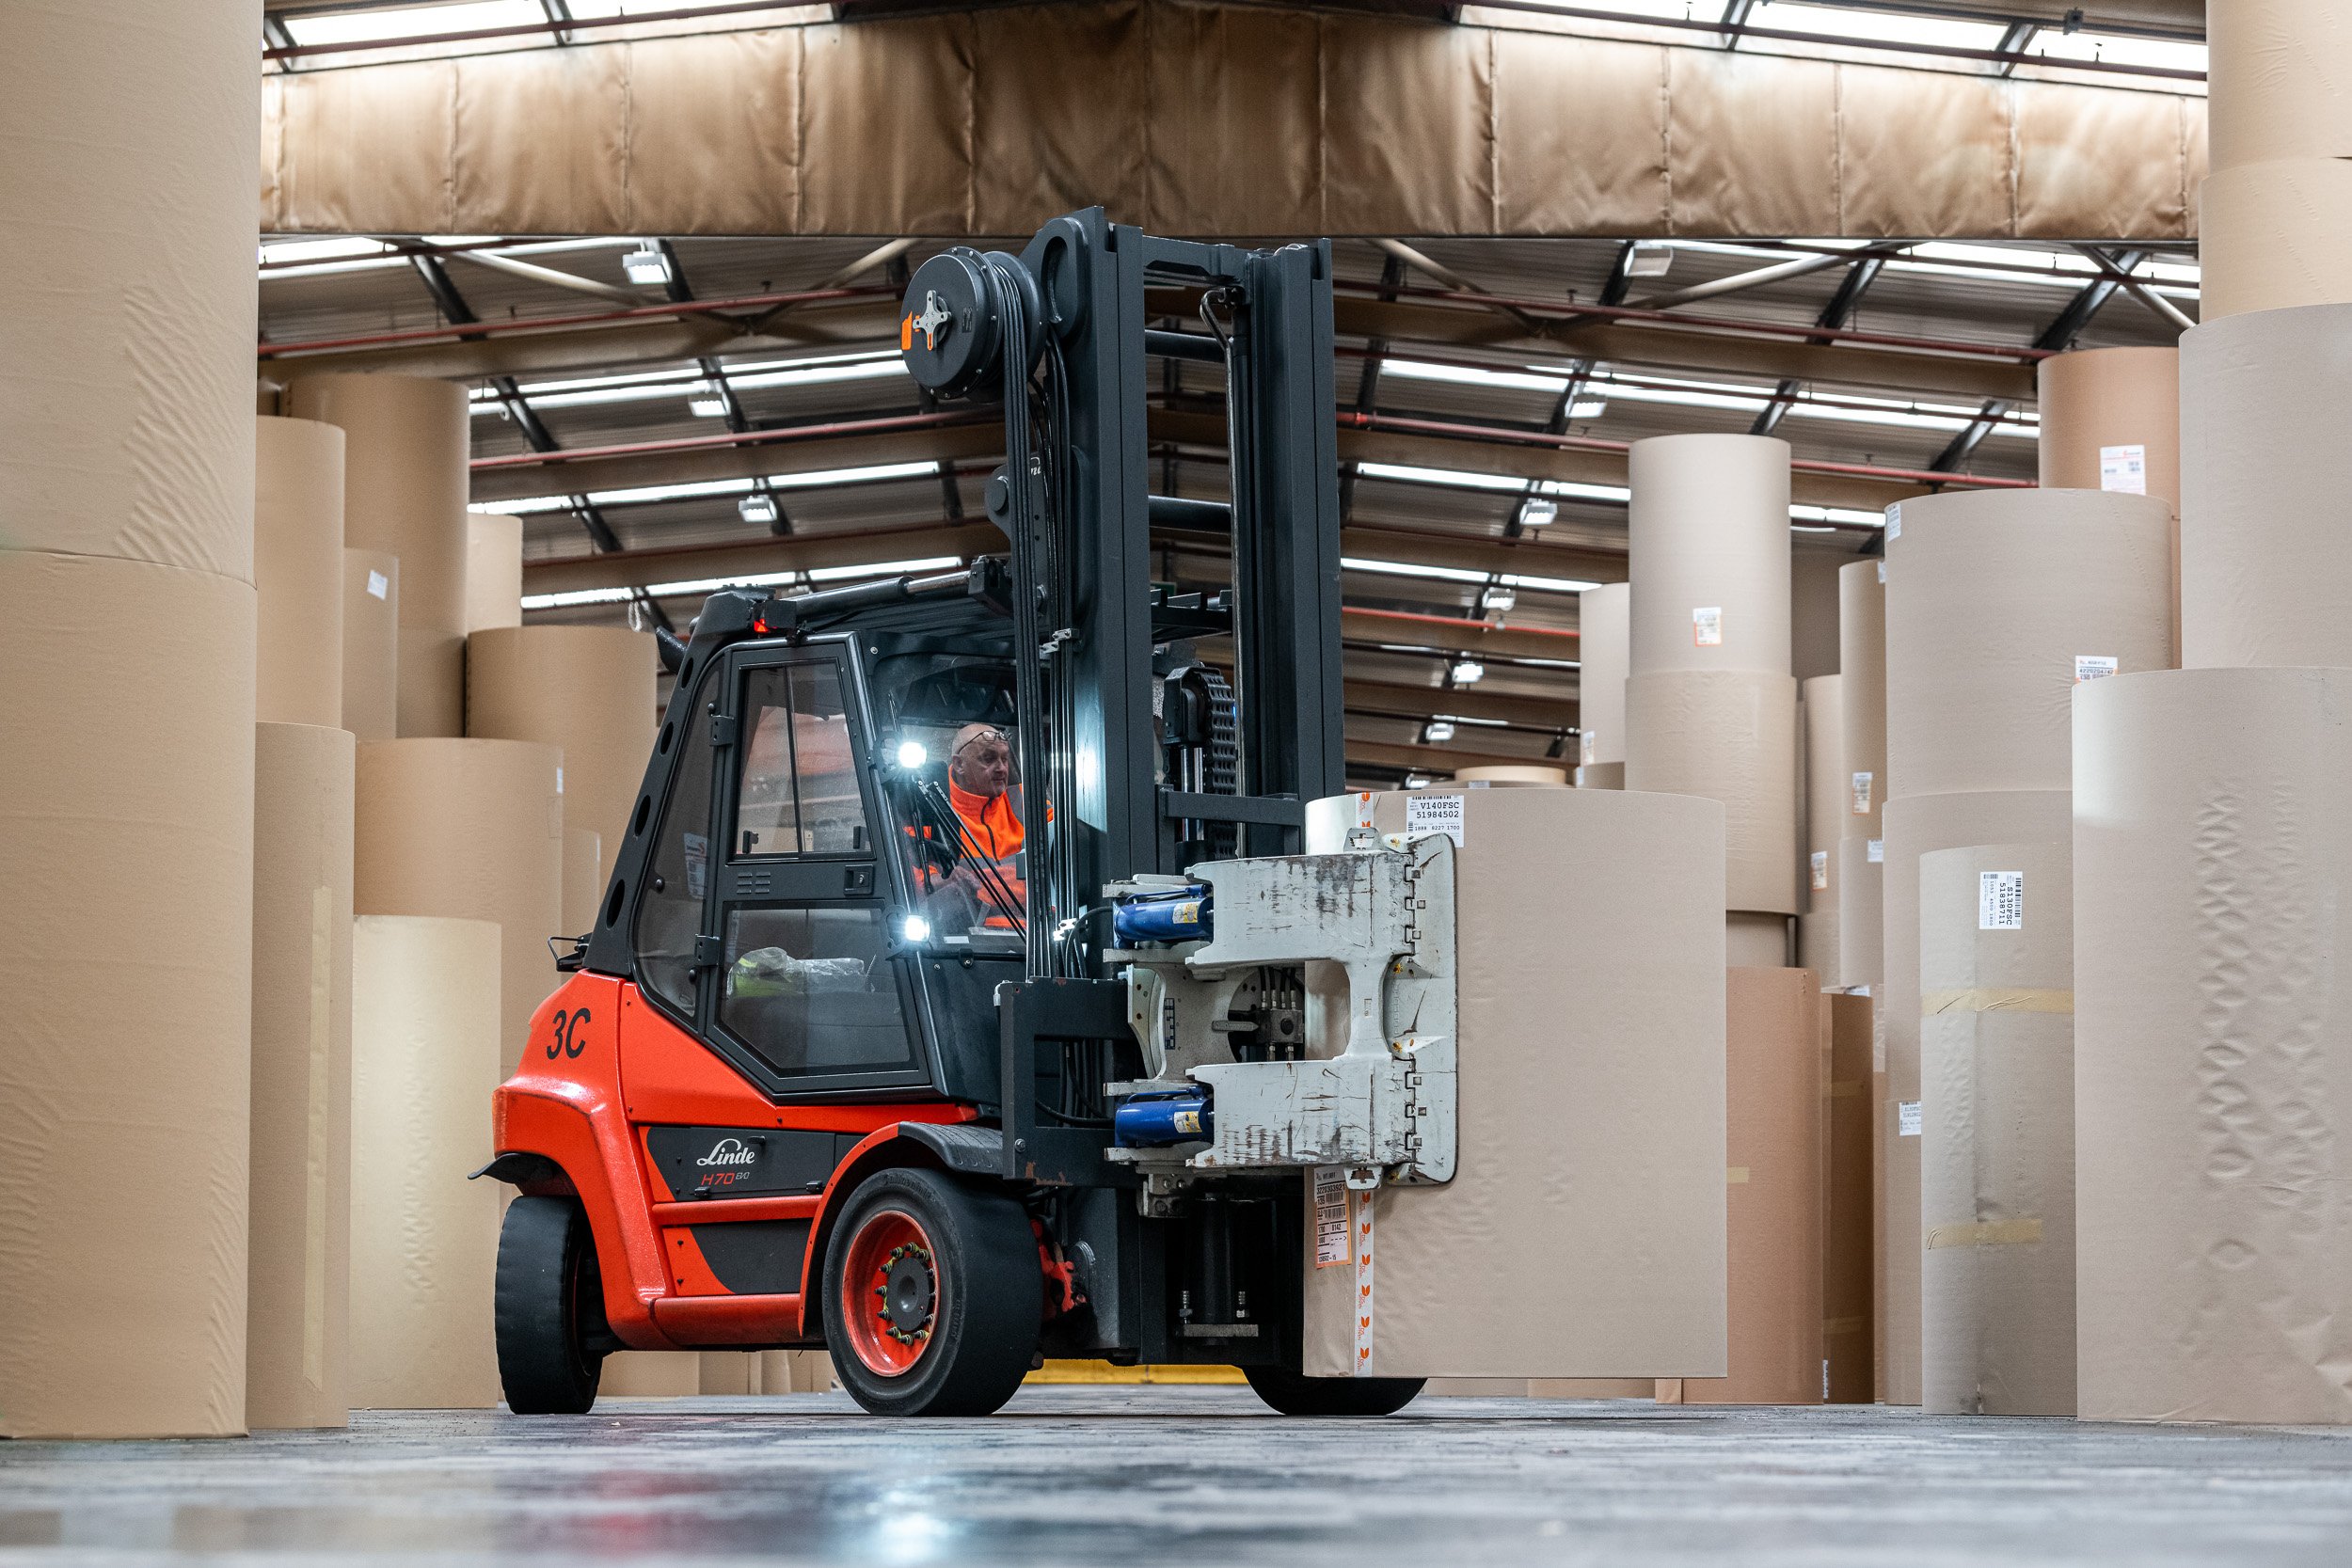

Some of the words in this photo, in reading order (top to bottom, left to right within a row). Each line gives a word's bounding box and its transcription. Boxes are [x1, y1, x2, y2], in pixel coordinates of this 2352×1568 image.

[1420, 801, 1460, 810] V140FSC
[1416, 810, 1459, 819] 51984502
[547, 1007, 591, 1060] 3C
[696, 1138, 755, 1166] Linde
[701, 1172, 735, 1185] H70
